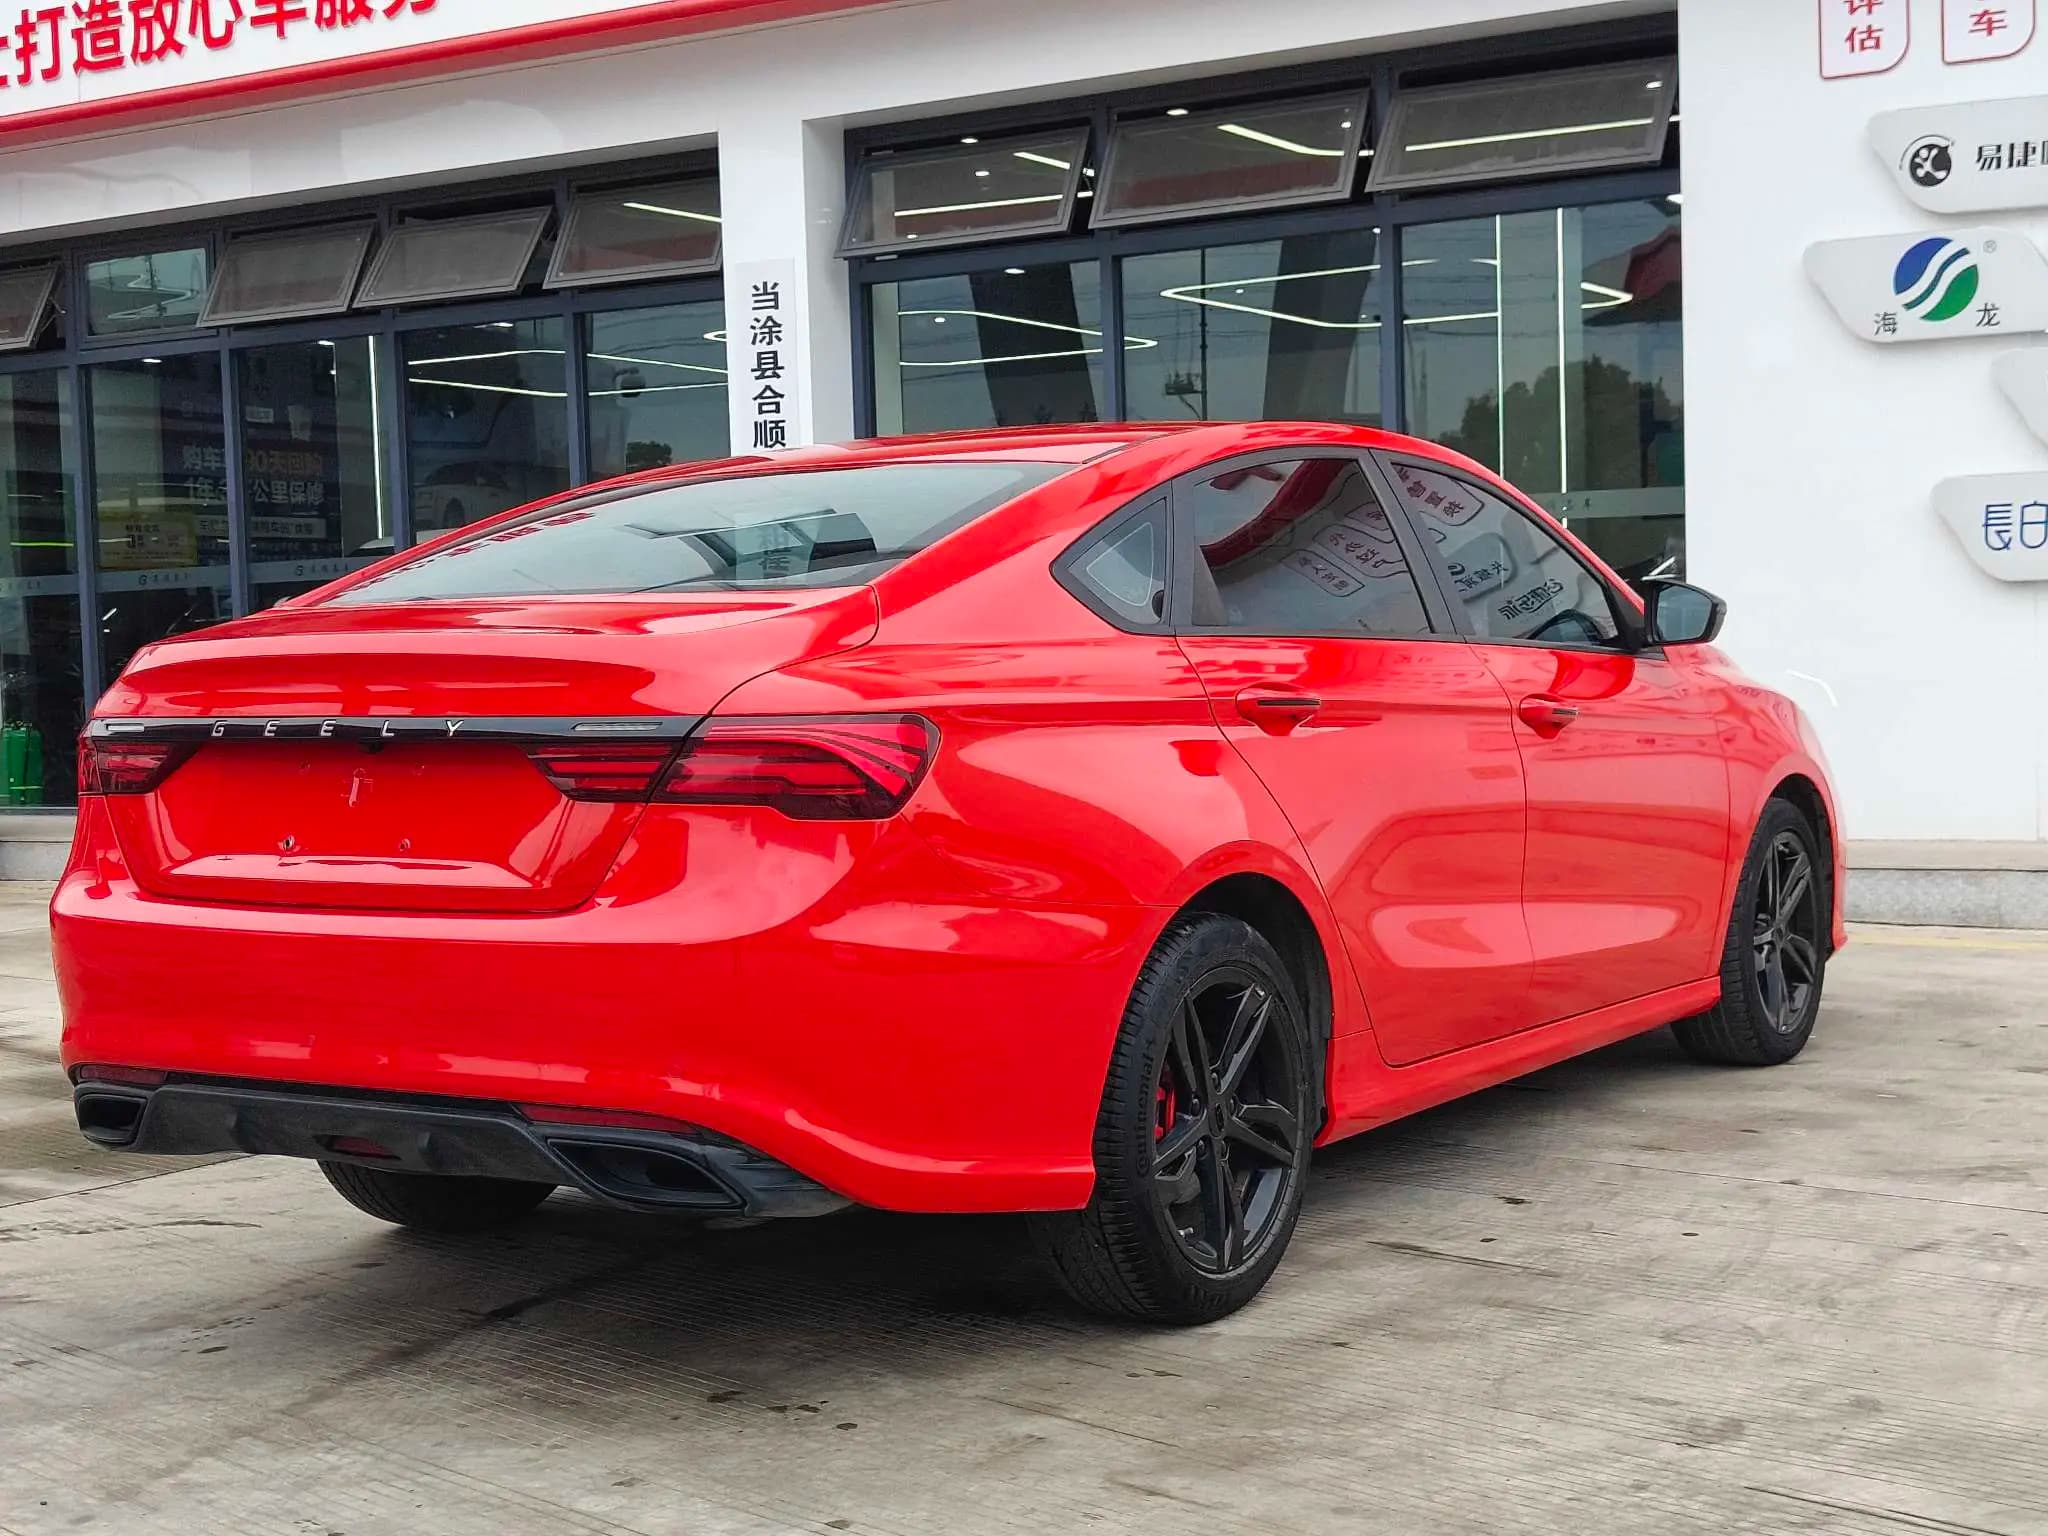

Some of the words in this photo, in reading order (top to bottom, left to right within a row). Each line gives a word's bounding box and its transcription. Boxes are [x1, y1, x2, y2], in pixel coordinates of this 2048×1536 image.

[1874, 311, 1898, 336] 海
[1976, 302, 2001, 328] 龙
[750, 281, 786, 449] 当涂县合顺
[210, 719, 465, 738] GEELY
